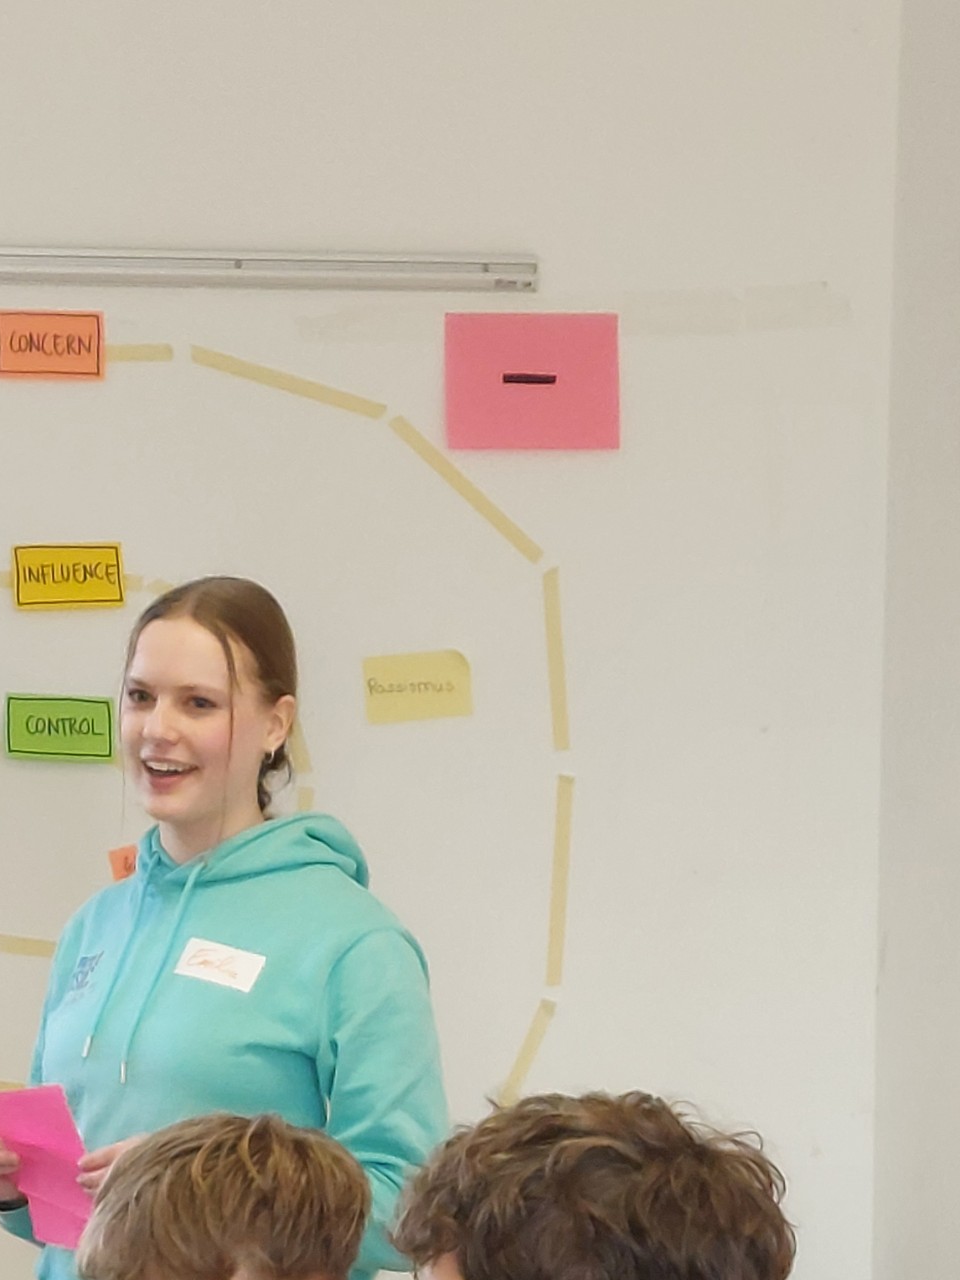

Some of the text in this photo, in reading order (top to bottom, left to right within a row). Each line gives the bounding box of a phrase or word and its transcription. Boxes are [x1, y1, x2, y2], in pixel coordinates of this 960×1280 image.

[9, 329, 93, 357] CONCERN
[22, 561, 117, 585] INFLUENCE
[25, 714, 105, 737] CONTROL
